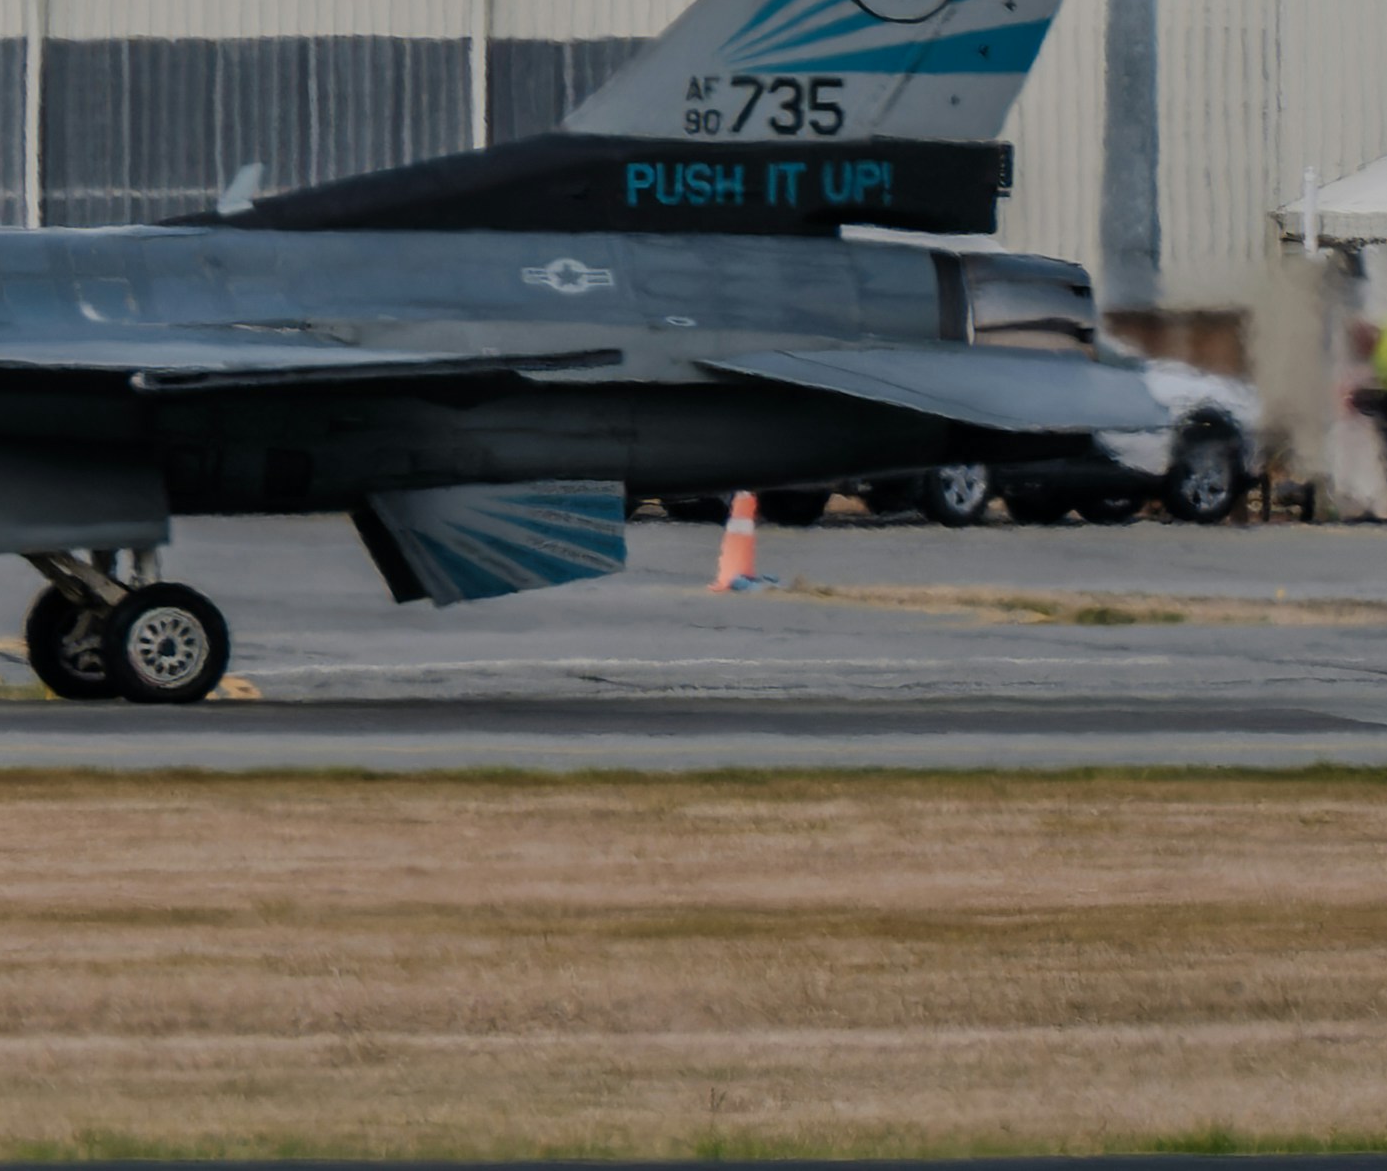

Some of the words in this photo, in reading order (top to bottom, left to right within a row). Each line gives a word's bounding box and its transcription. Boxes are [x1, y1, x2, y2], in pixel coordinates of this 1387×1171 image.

[686, 76, 720, 101] AF
[731, 75, 844, 135] 735
[685, 109, 721, 134] 90
[627, 161, 743, 206] PUSH
[767, 162, 807, 206] IT
[822, 160, 892, 206] UP!
